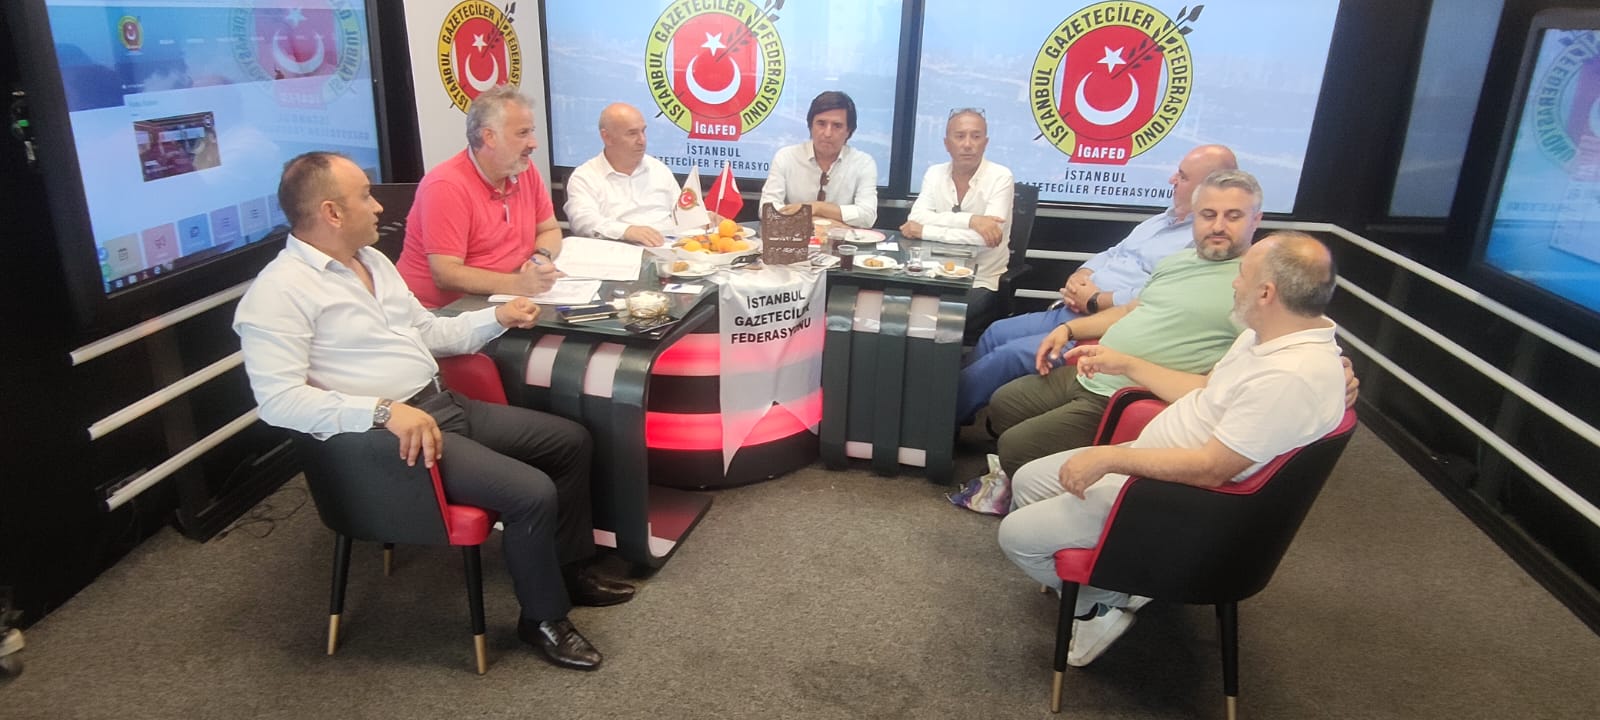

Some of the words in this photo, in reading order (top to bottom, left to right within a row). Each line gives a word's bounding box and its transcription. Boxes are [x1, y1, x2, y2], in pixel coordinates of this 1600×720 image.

[1045, 3, 1155, 61] GAZETECİLER
[442, 2, 495, 44] GAZETECİLER
[504, 31, 520, 87] FEDERASY
[650, 52, 685, 124] İSTANBUL
[743, 31, 781, 125] FEDERASYONU
[1033, 68, 1069, 146] İSTANBUL
[1135, 47, 1188, 149] FEDERASYONU
[695, 121, 736, 136] İGAFED
[687, 143, 741, 158] İSTANBUL
[1078, 143, 1126, 160] İGAFED
[654, 155, 710, 168] ETECİLER
[1064, 167, 1127, 183] İSTANBUL
[1017, 181, 1089, 196] ETECİLER
[1094, 185, 1173, 199] FEDERASYONU
[747, 290, 806, 309] İSTANBUL
